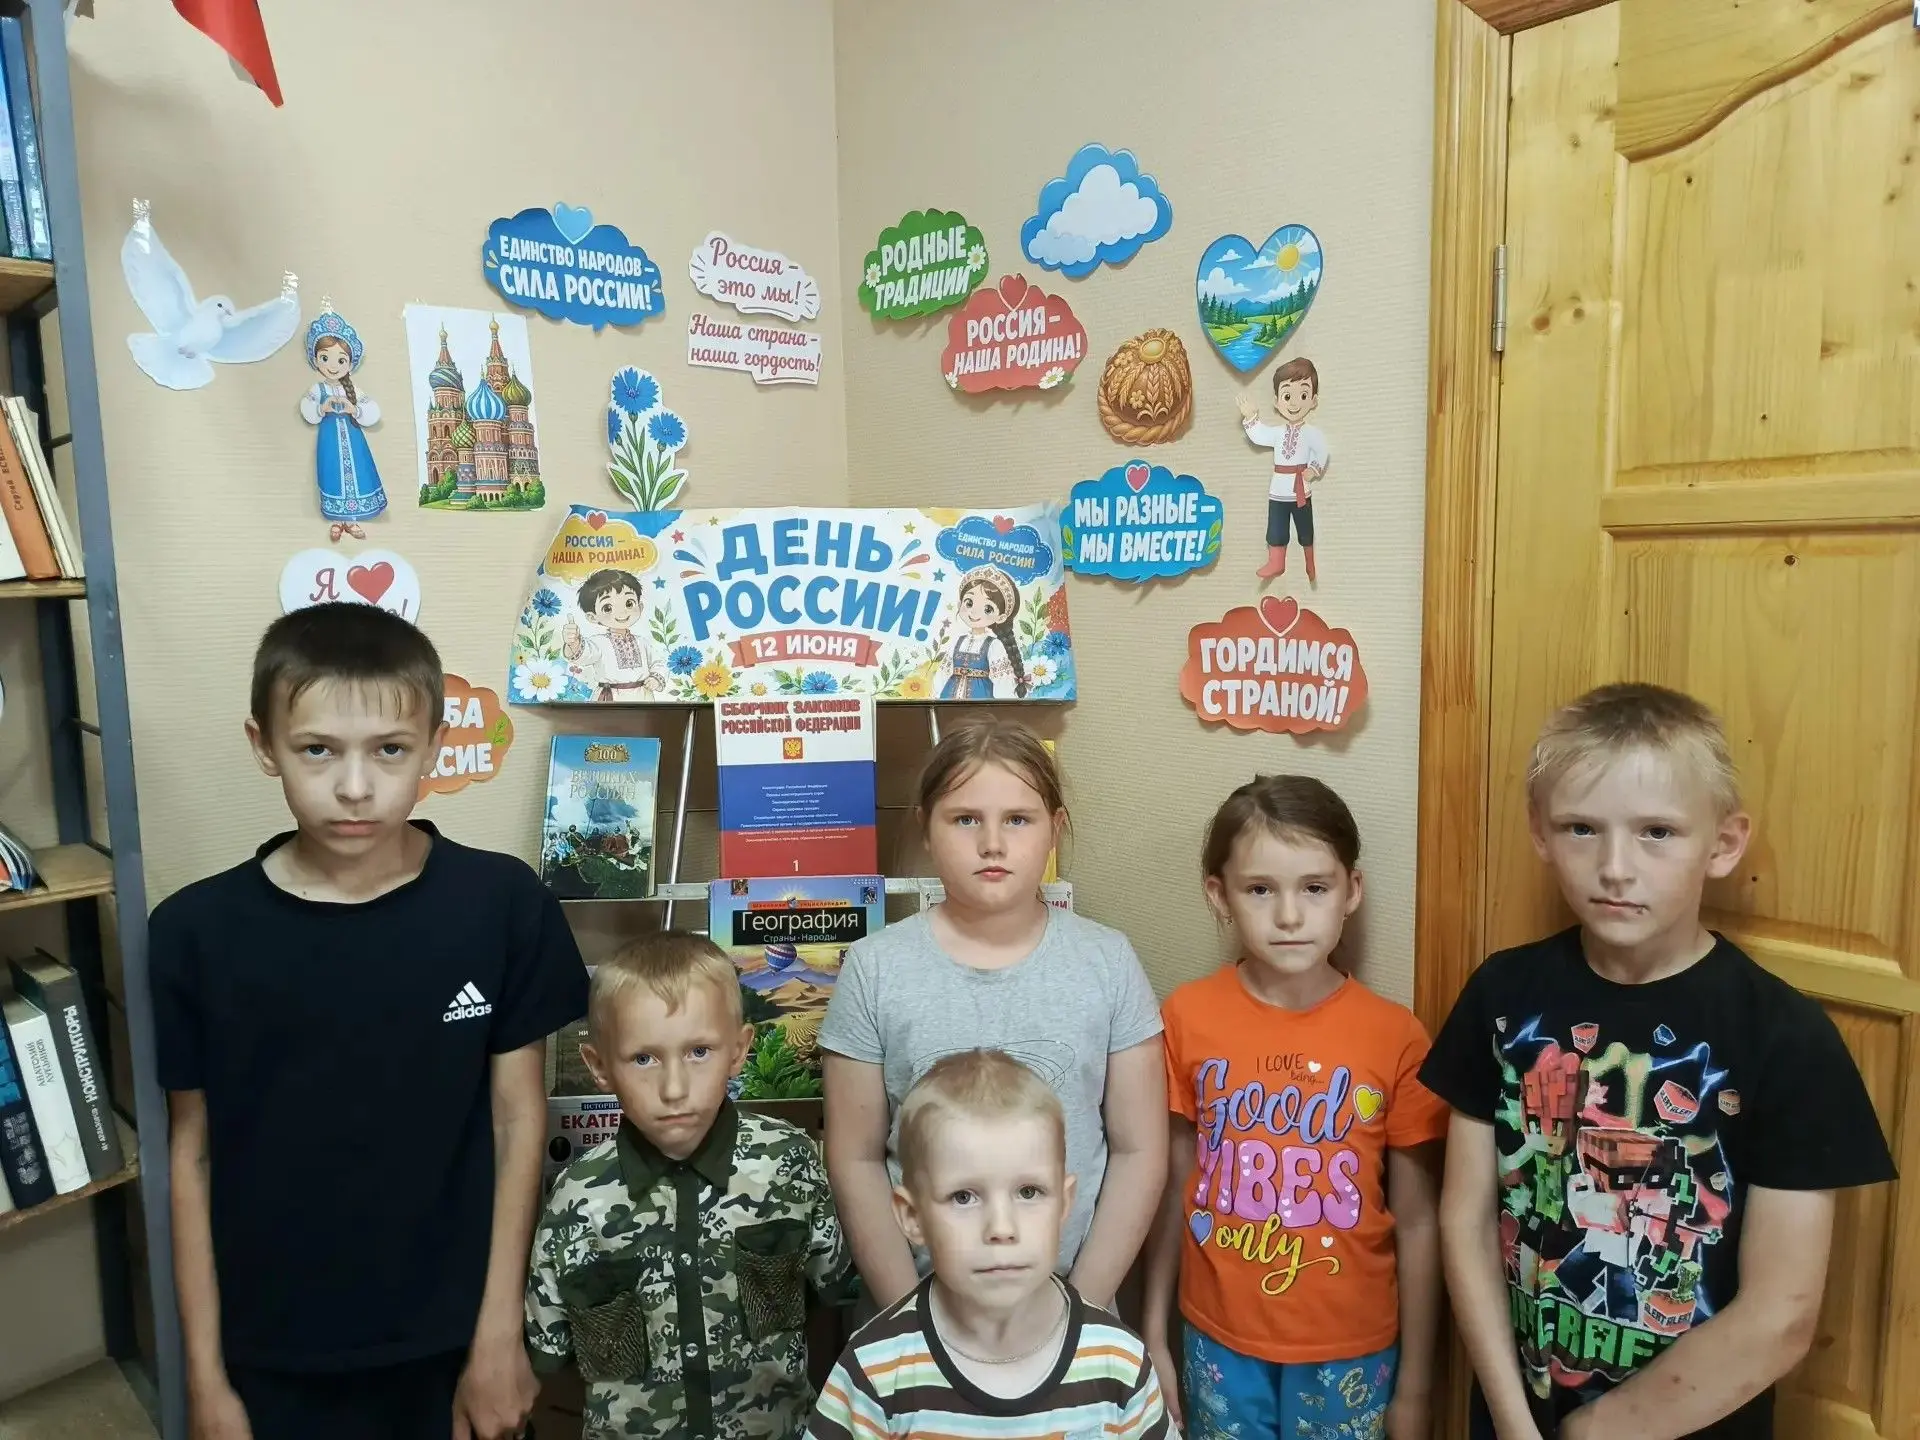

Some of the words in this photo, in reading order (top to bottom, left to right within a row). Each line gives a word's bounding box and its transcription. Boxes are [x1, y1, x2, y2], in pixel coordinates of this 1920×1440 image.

[499, 234, 575, 268] ЕДИНСТВО
[709, 236, 784, 276] Россия
[881, 224, 967, 276] РОДНЫЕ
[499, 263, 560, 302] СИЛА
[565, 277, 652, 311] РОССИИ!
[717, 279, 756, 299] это
[761, 280, 801, 305] мы!
[875, 265, 972, 311] ТРАДИЦИИ
[690, 313, 742, 340] Наша
[691, 347, 739, 365] наша
[744, 352, 821, 376] гордость!
[953, 348, 1001, 375] НАША
[1006, 332, 1081, 369] РОДИНА!
[1074, 497, 1109, 528] МЫ
[564, 535, 614, 549] РОССИЯ
[716, 517, 894, 581] ДЕНЬ
[957, 532, 997, 548] ЕДИНСТВО
[1079, 531, 1114, 563] МЫ
[1120, 529, 1207, 563] ВМЕСТЕ!
[552, 551, 584, 564] НАША
[588, 547, 645, 564] РОДИНА!
[955, 544, 985, 560] СИЛА
[988, 551, 1036, 569] РОССИИ!
[309, 567, 340, 601] Я
[682, 574, 942, 643] РОССИИ!
[751, 637, 778, 658] 12
[786, 633, 858, 657] ИЮНЯ
[1199, 637, 1353, 682] ГОРДИМСЯ
[720, 701, 789, 716] СБОРНИК
[793, 699, 861, 714] ЗАКОНОВ
[1202, 678, 1350, 726] СТРАНОЙ!
[721, 716, 792, 734] РОССИЙСКОЙ
[795, 716, 861, 734] ФЕДЕРАЦИИ
[597, 749, 617, 760] 100
[791, 858, 800, 872] 1
[741, 910, 858, 934] География
[763, 934, 796, 943] Страны
[801, 933, 836, 943] Народы
[442, 1003, 492, 1023] adidas
[1256, 1057, 1260, 1074] I
[1265, 1053, 1304, 1072] LOVE
[1196, 1058, 1353, 1151] Good
[1195, 1132, 1362, 1230] VIBES
[1215, 1213, 1341, 1295] only
